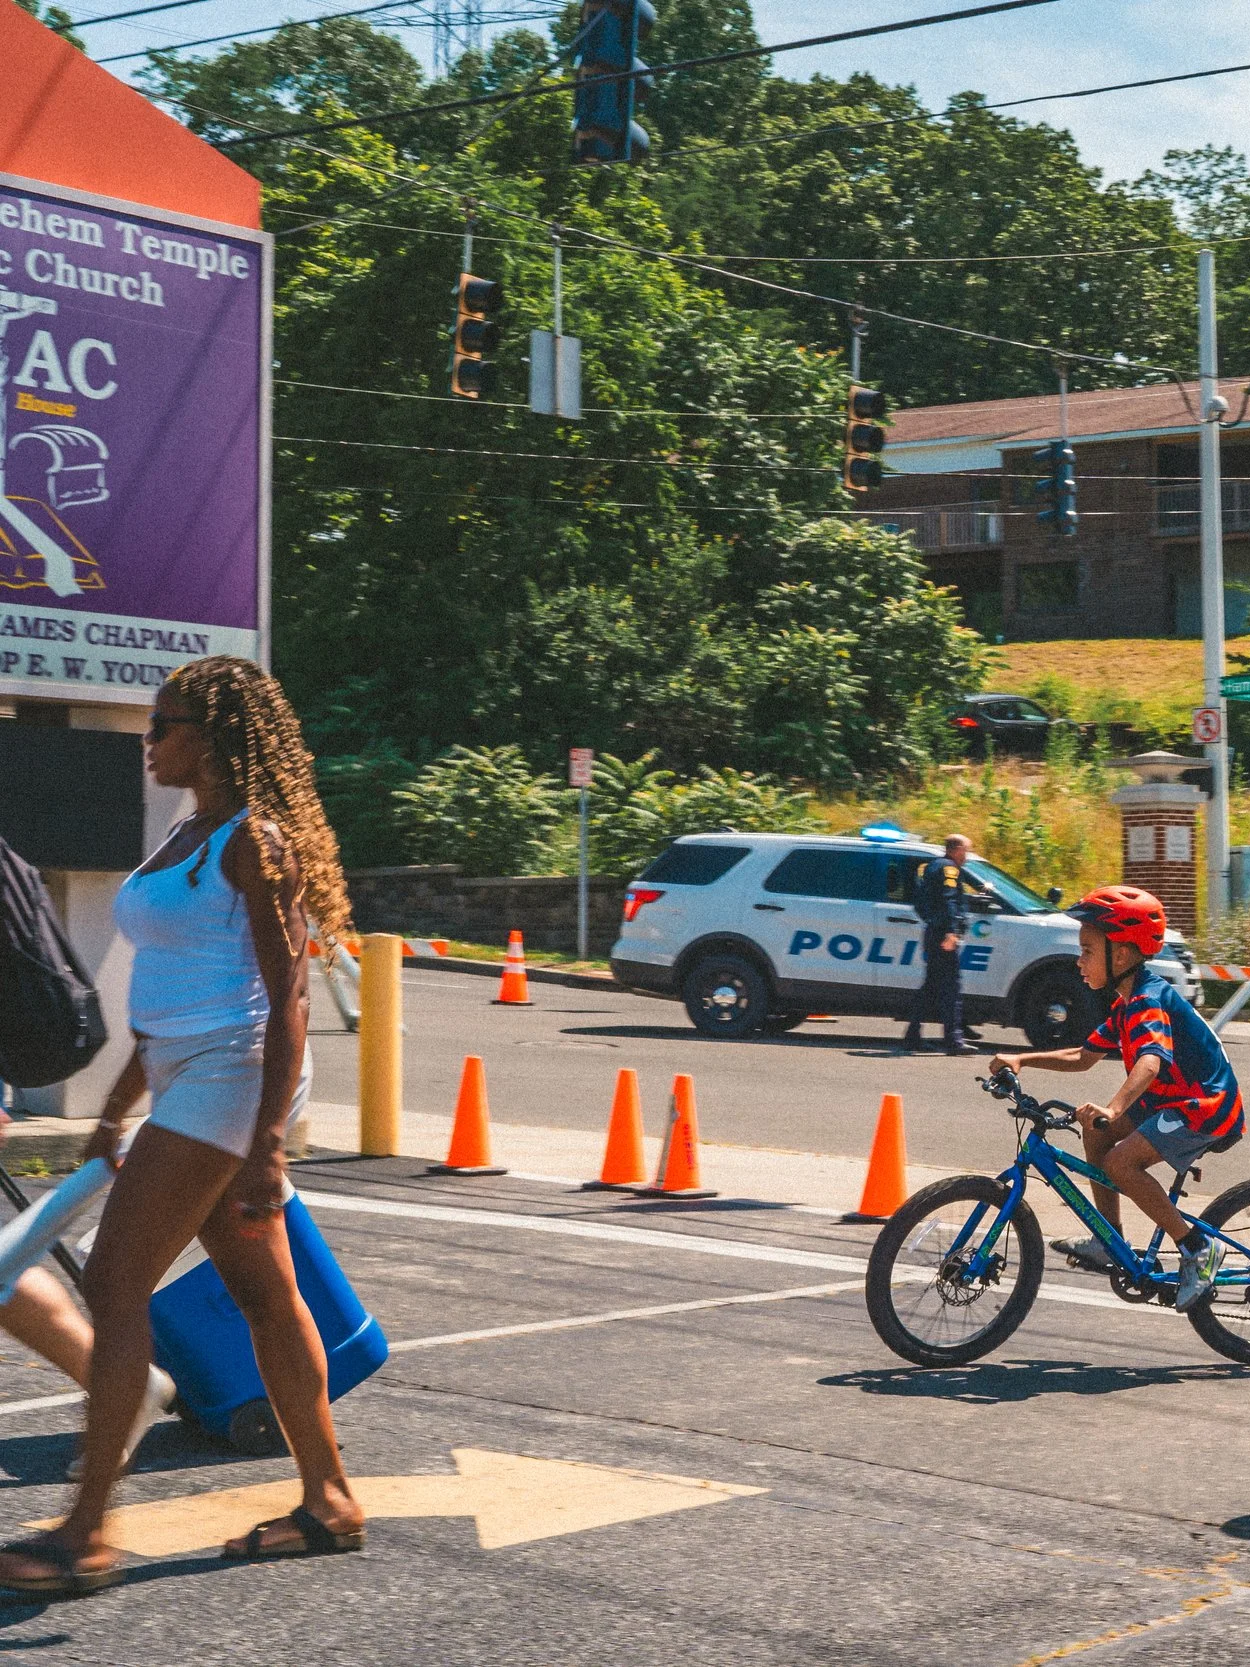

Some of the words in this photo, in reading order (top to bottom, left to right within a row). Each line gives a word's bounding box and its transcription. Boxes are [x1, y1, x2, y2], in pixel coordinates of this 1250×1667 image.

[115, 221, 249, 280] Temple
[25, 249, 165, 307] Church
[12, 329, 118, 400] AC
[0, 613, 76, 642] AMES
[84, 622, 209, 654] CHAPMAN
[61, 657, 92, 681] W.
[788, 930, 994, 971] POLIE
